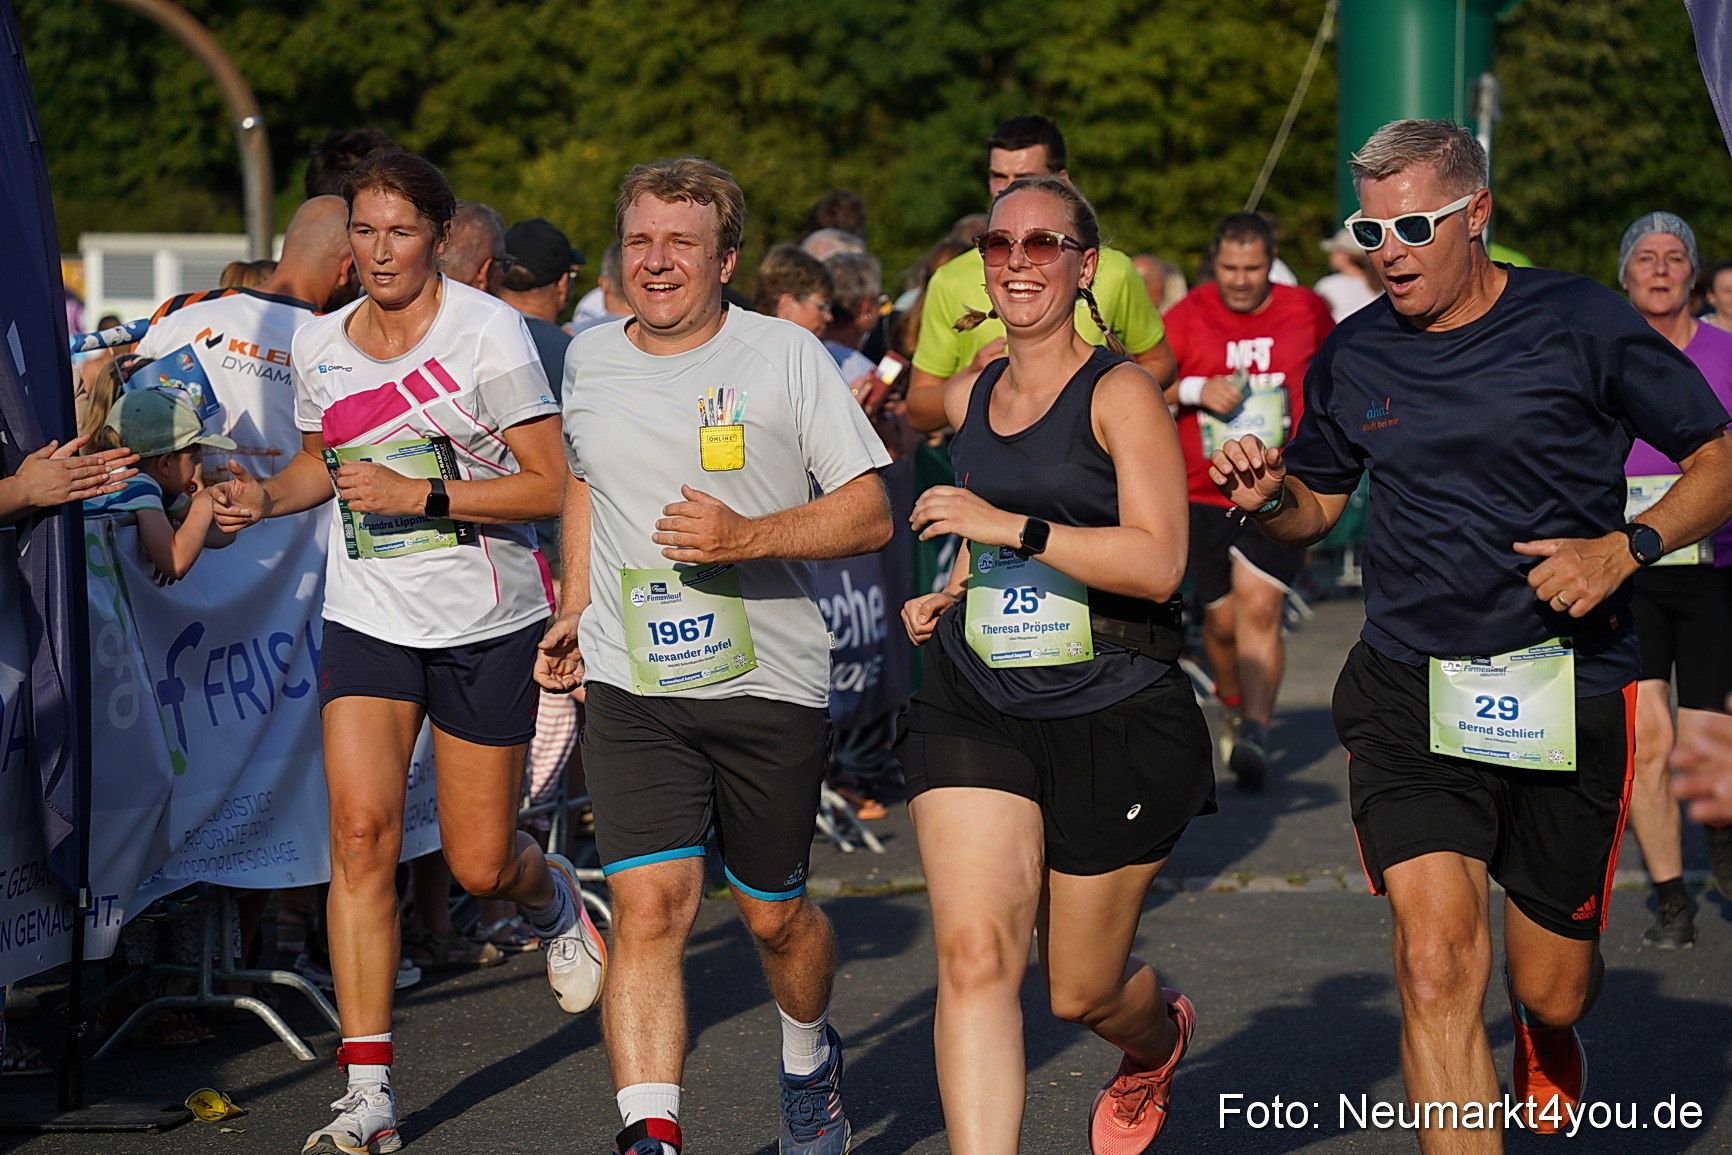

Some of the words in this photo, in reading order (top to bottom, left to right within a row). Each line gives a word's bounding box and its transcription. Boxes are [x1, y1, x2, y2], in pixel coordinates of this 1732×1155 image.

[1366, 397, 1391, 419] aha!
[646, 591, 682, 603] Firmenlauf
[1002, 587, 1039, 615] 25
[647, 613, 715, 646] 1967
[981, 624, 1020, 635] Theresa
[1022, 621, 1071, 635] Pröpster
[648, 647, 702, 663] Alexander
[703, 638, 733, 656] Apfel
[1475, 694, 1520, 721] 29
[1458, 720, 1494, 735] Bernd
[1496, 726, 1546, 739] Schlierf
[177, 852, 248, 881] CORPORATE
[246, 840, 300, 871] SIGNAGE
